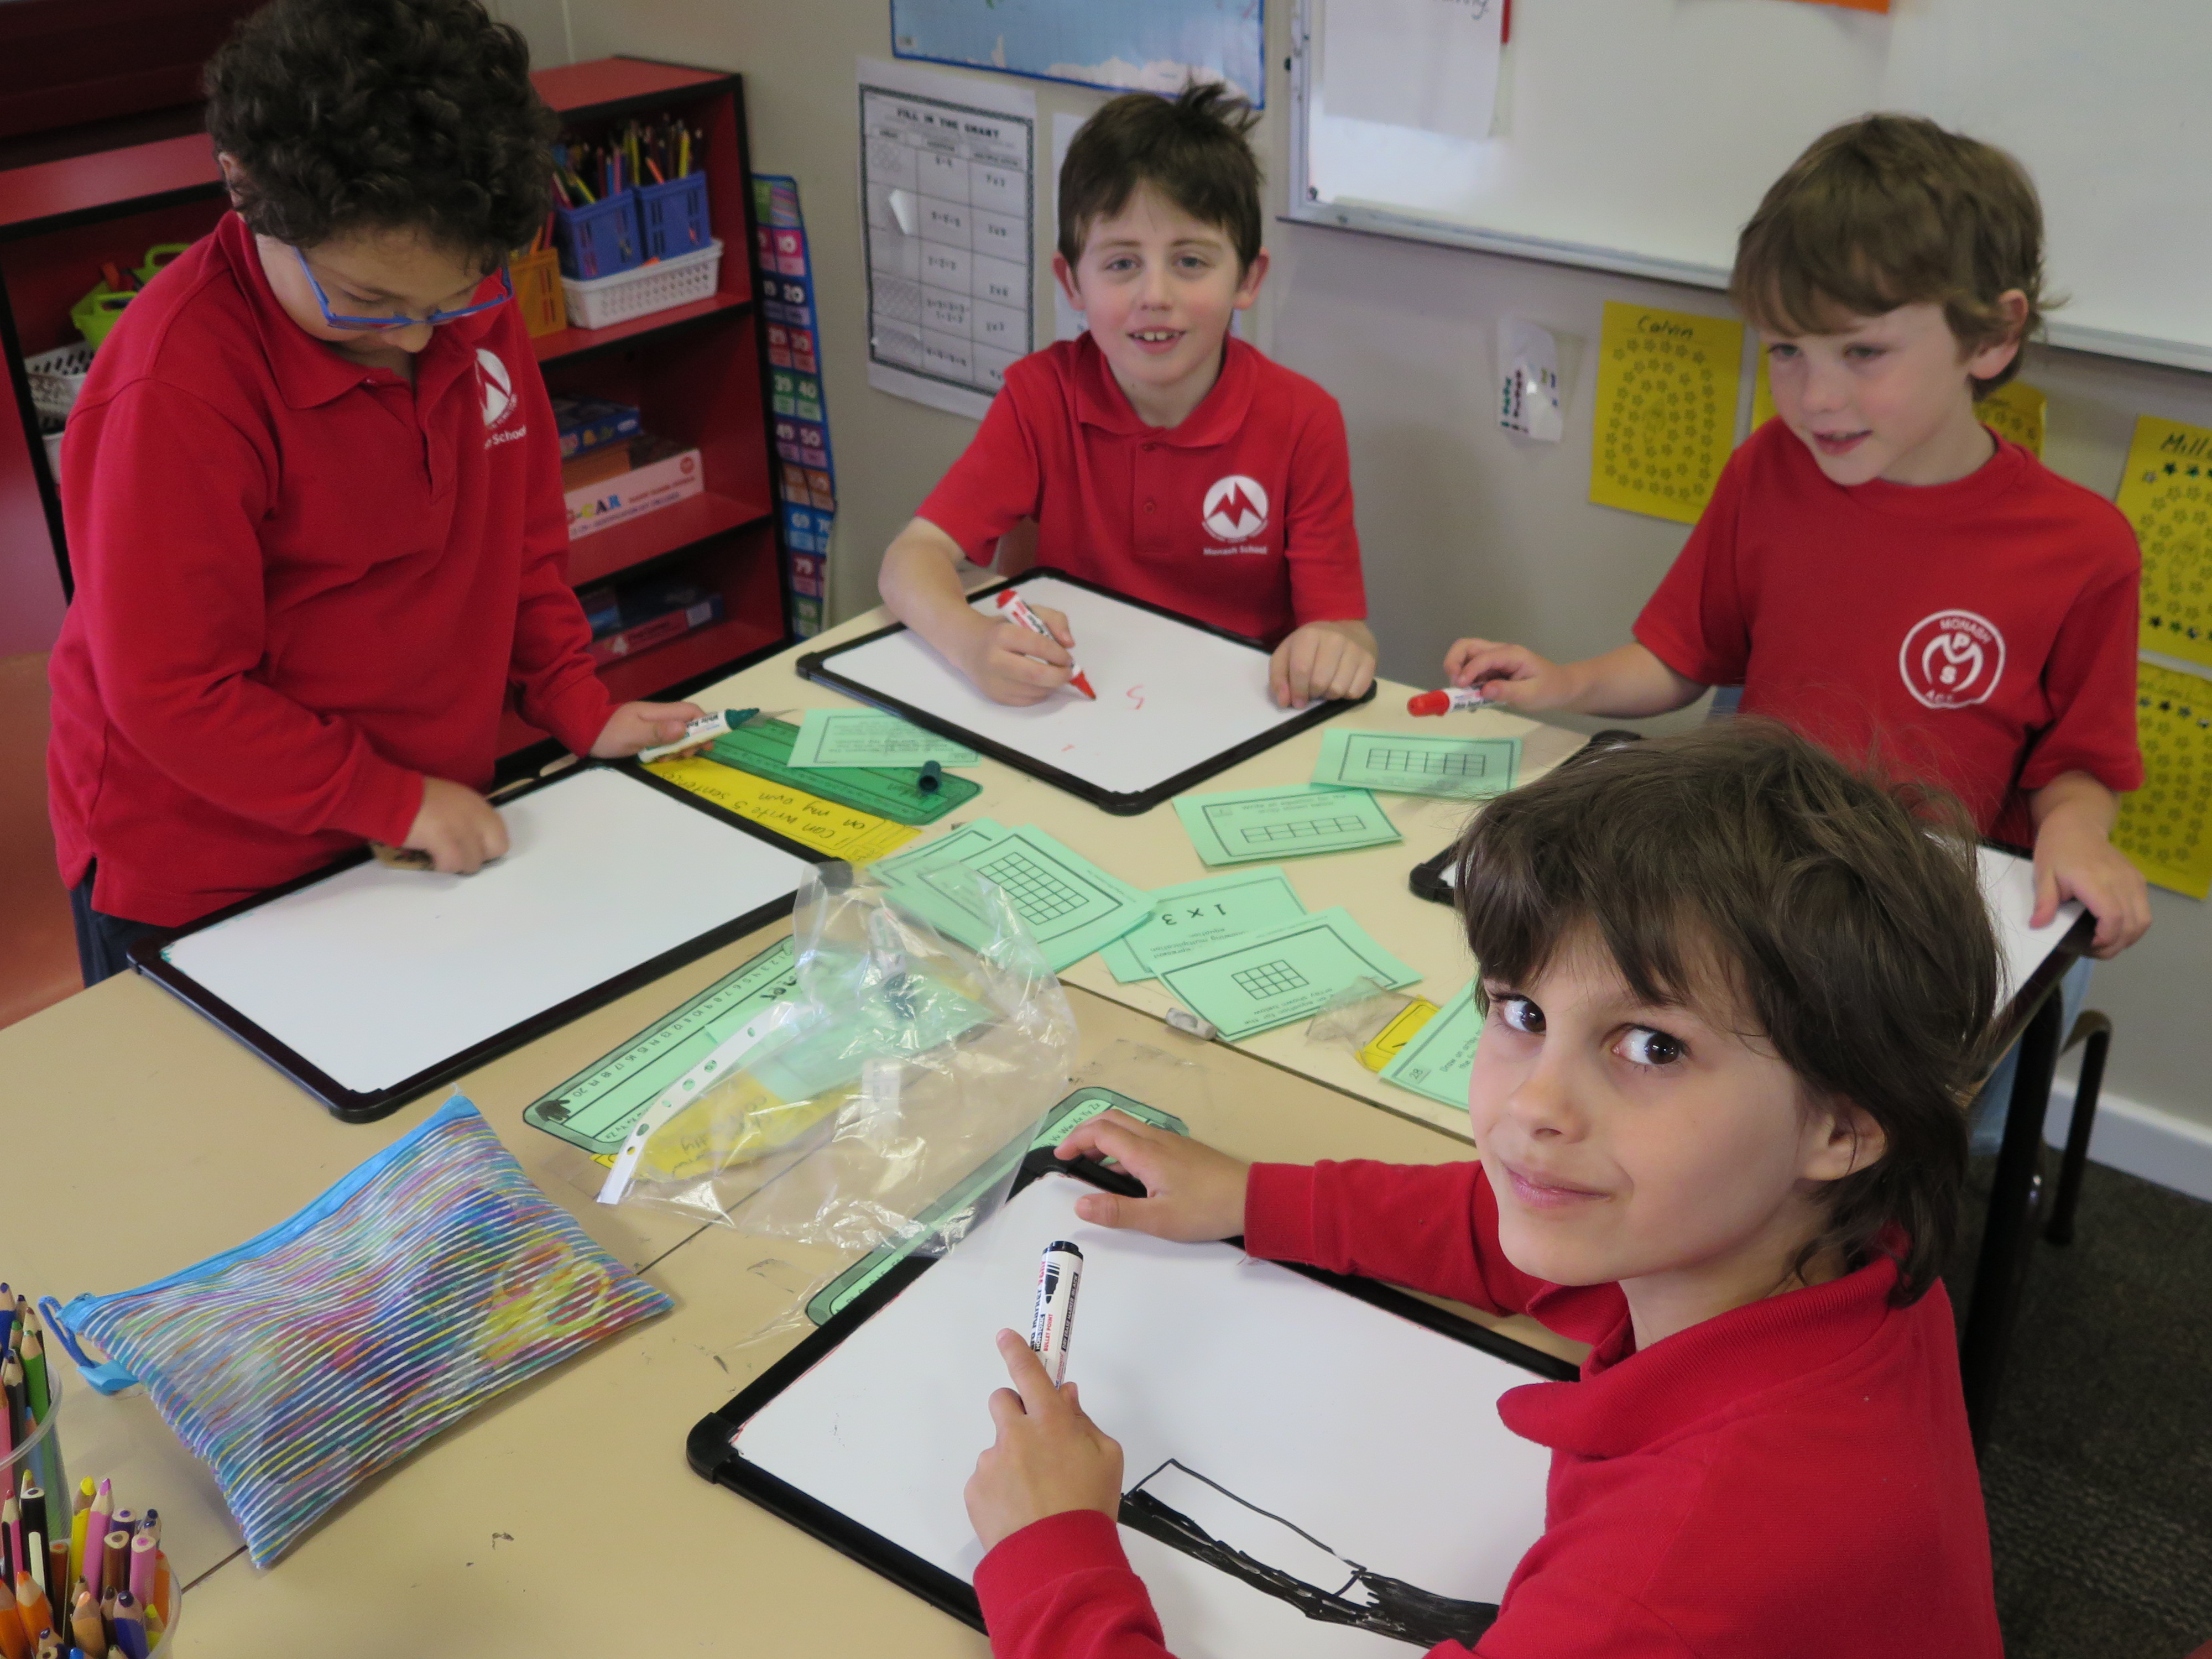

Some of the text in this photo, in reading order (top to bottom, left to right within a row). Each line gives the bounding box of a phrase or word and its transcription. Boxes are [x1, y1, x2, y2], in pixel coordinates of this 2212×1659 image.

[2159, 430, 2212, 457] Mill
[758, 791, 794, 805] own
[732, 801, 748, 811] 5
[802, 800, 830, 817] my
[1214, 904, 1226, 916] 1
[1161, 914, 1177, 926] 3
[573, 1089, 587, 1097] 20
